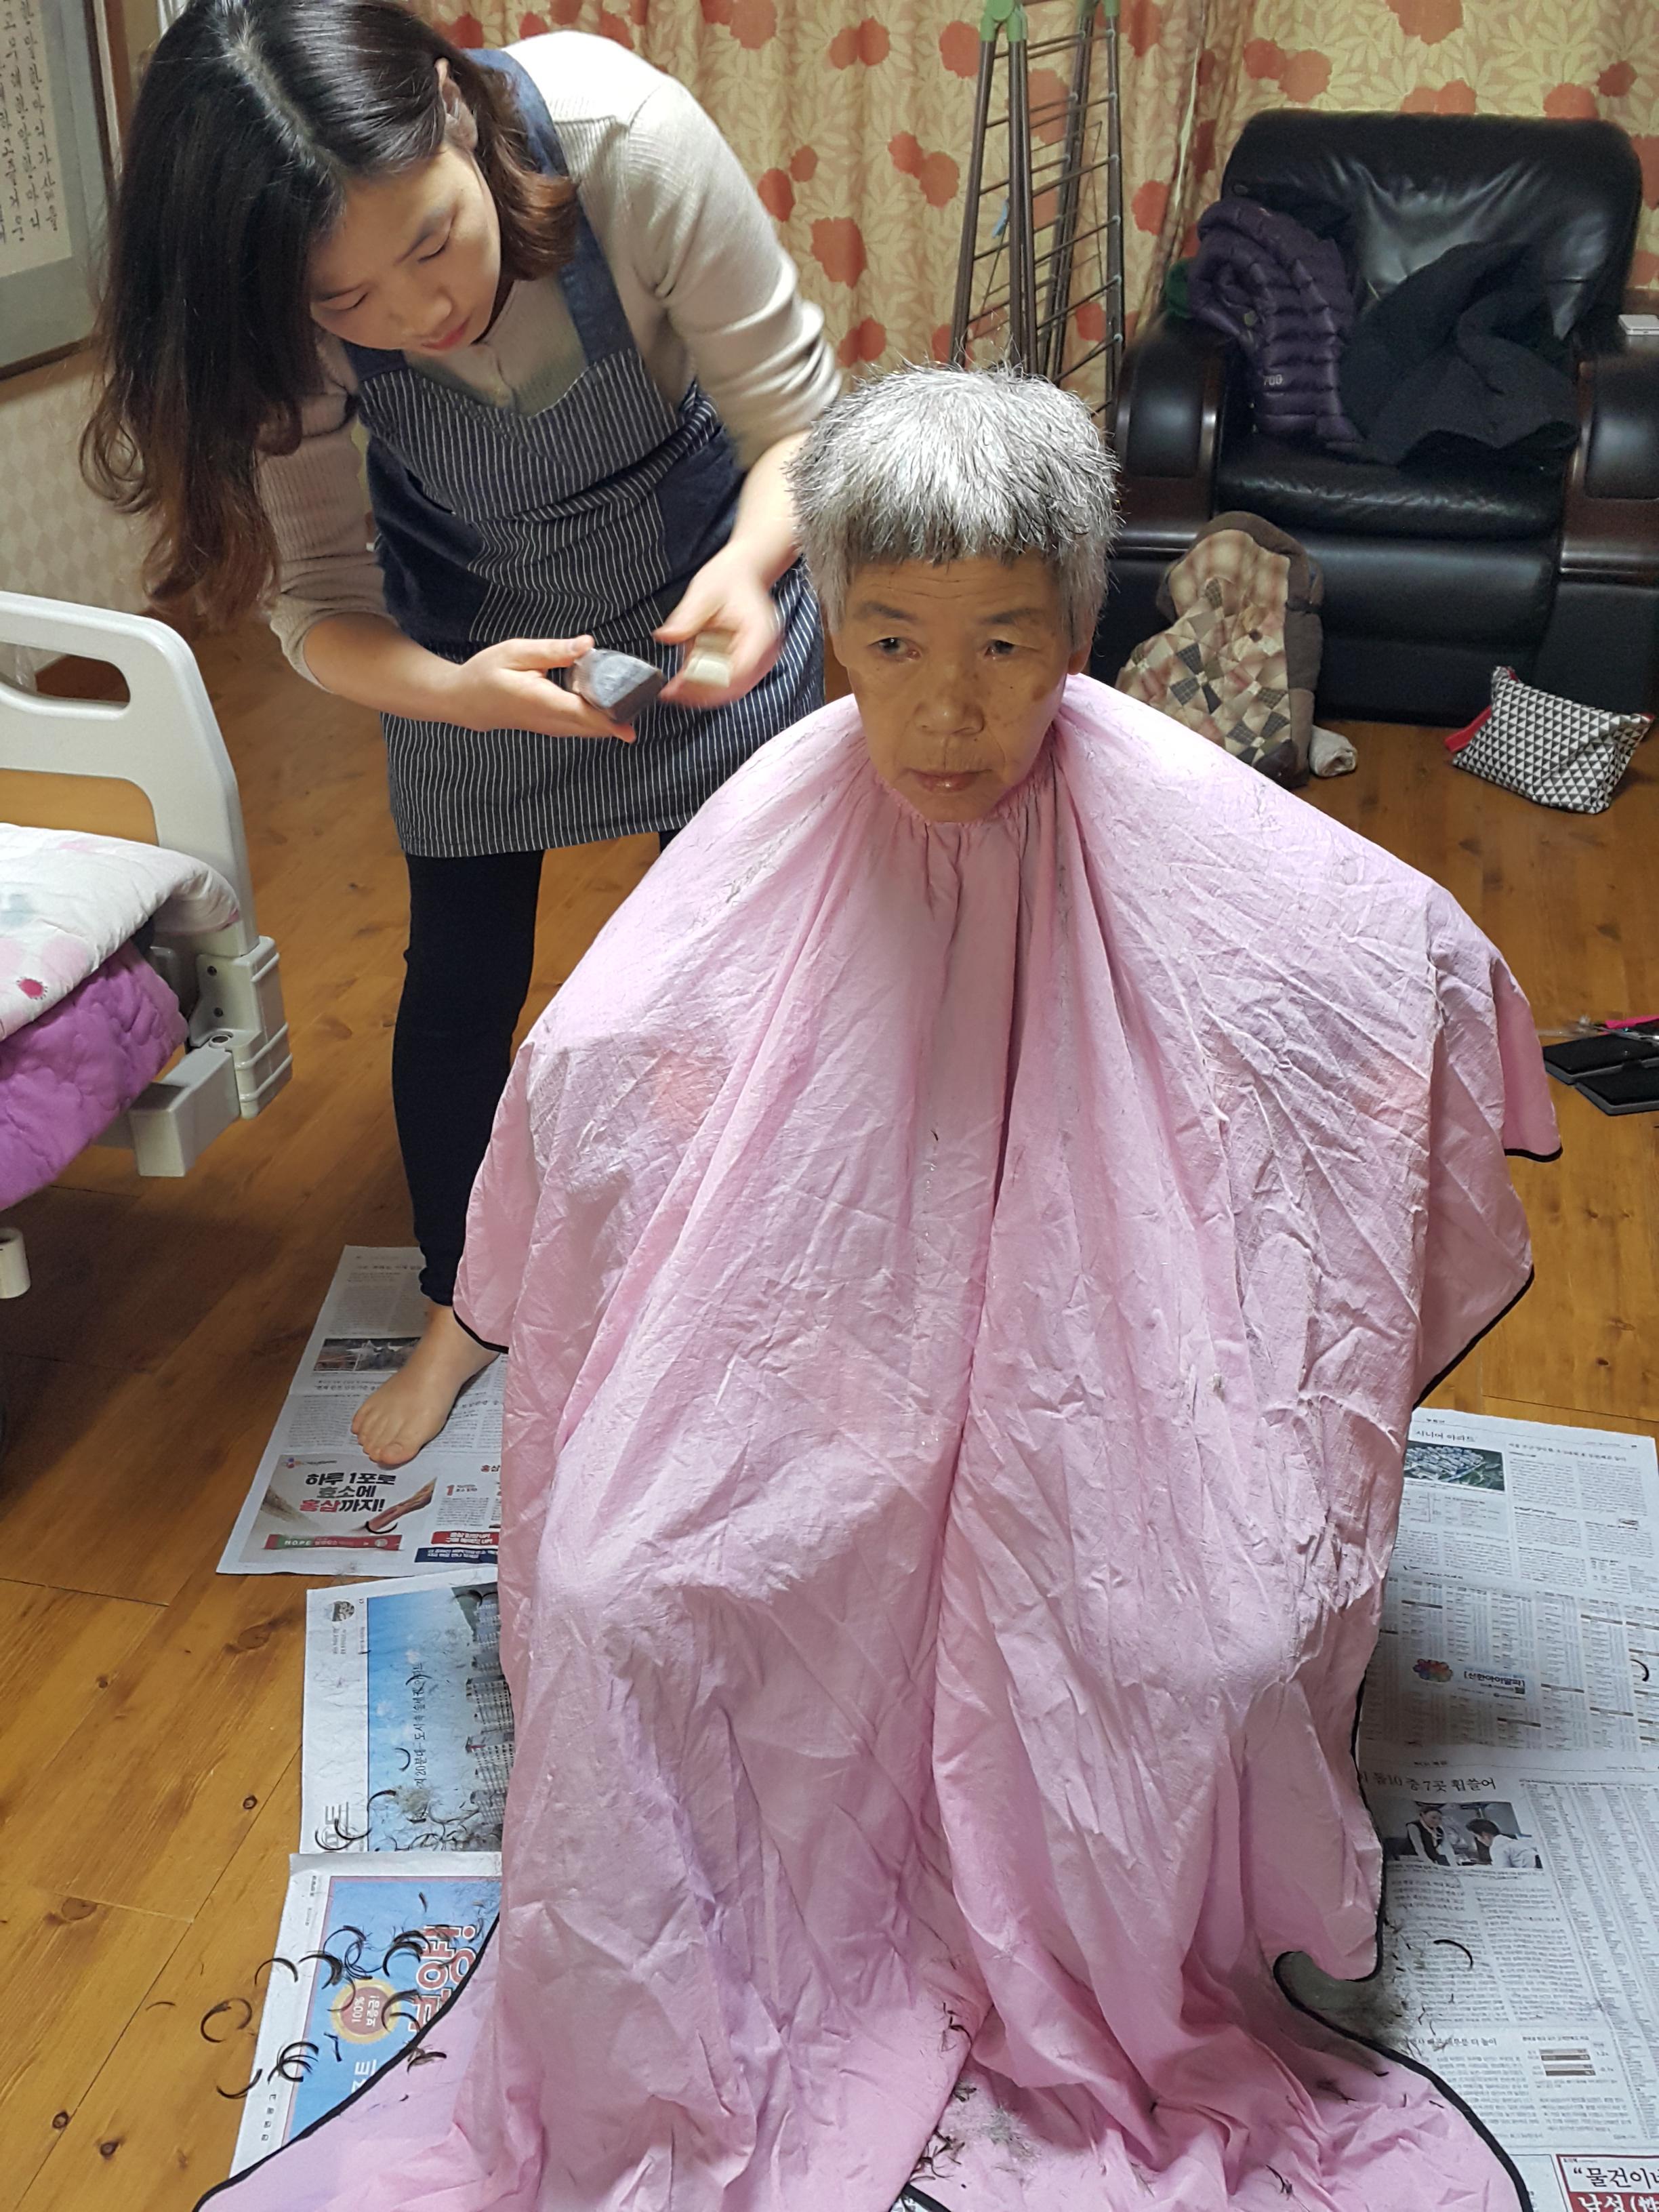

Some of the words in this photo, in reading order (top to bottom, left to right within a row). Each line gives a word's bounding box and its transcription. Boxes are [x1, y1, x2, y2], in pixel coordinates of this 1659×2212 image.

[1447, 1434, 1476, 1443] 아파트
[306, 1473, 344, 1486] 하루
[350, 1473, 396, 1486] 1포로
[316, 1485, 377, 1498] 효소에
[447, 1484, 455, 1496] 1
[300, 1499, 386, 1513] 홍삼까지!
[413, 1723, 427, 1740] 도시
[1406, 1777, 1420, 1791] 중
[1422, 1780, 1448, 1793] 7곳
[1450, 1777, 1496, 1792] 휩쓸어
[351, 1996, 365, 2024] 100%
